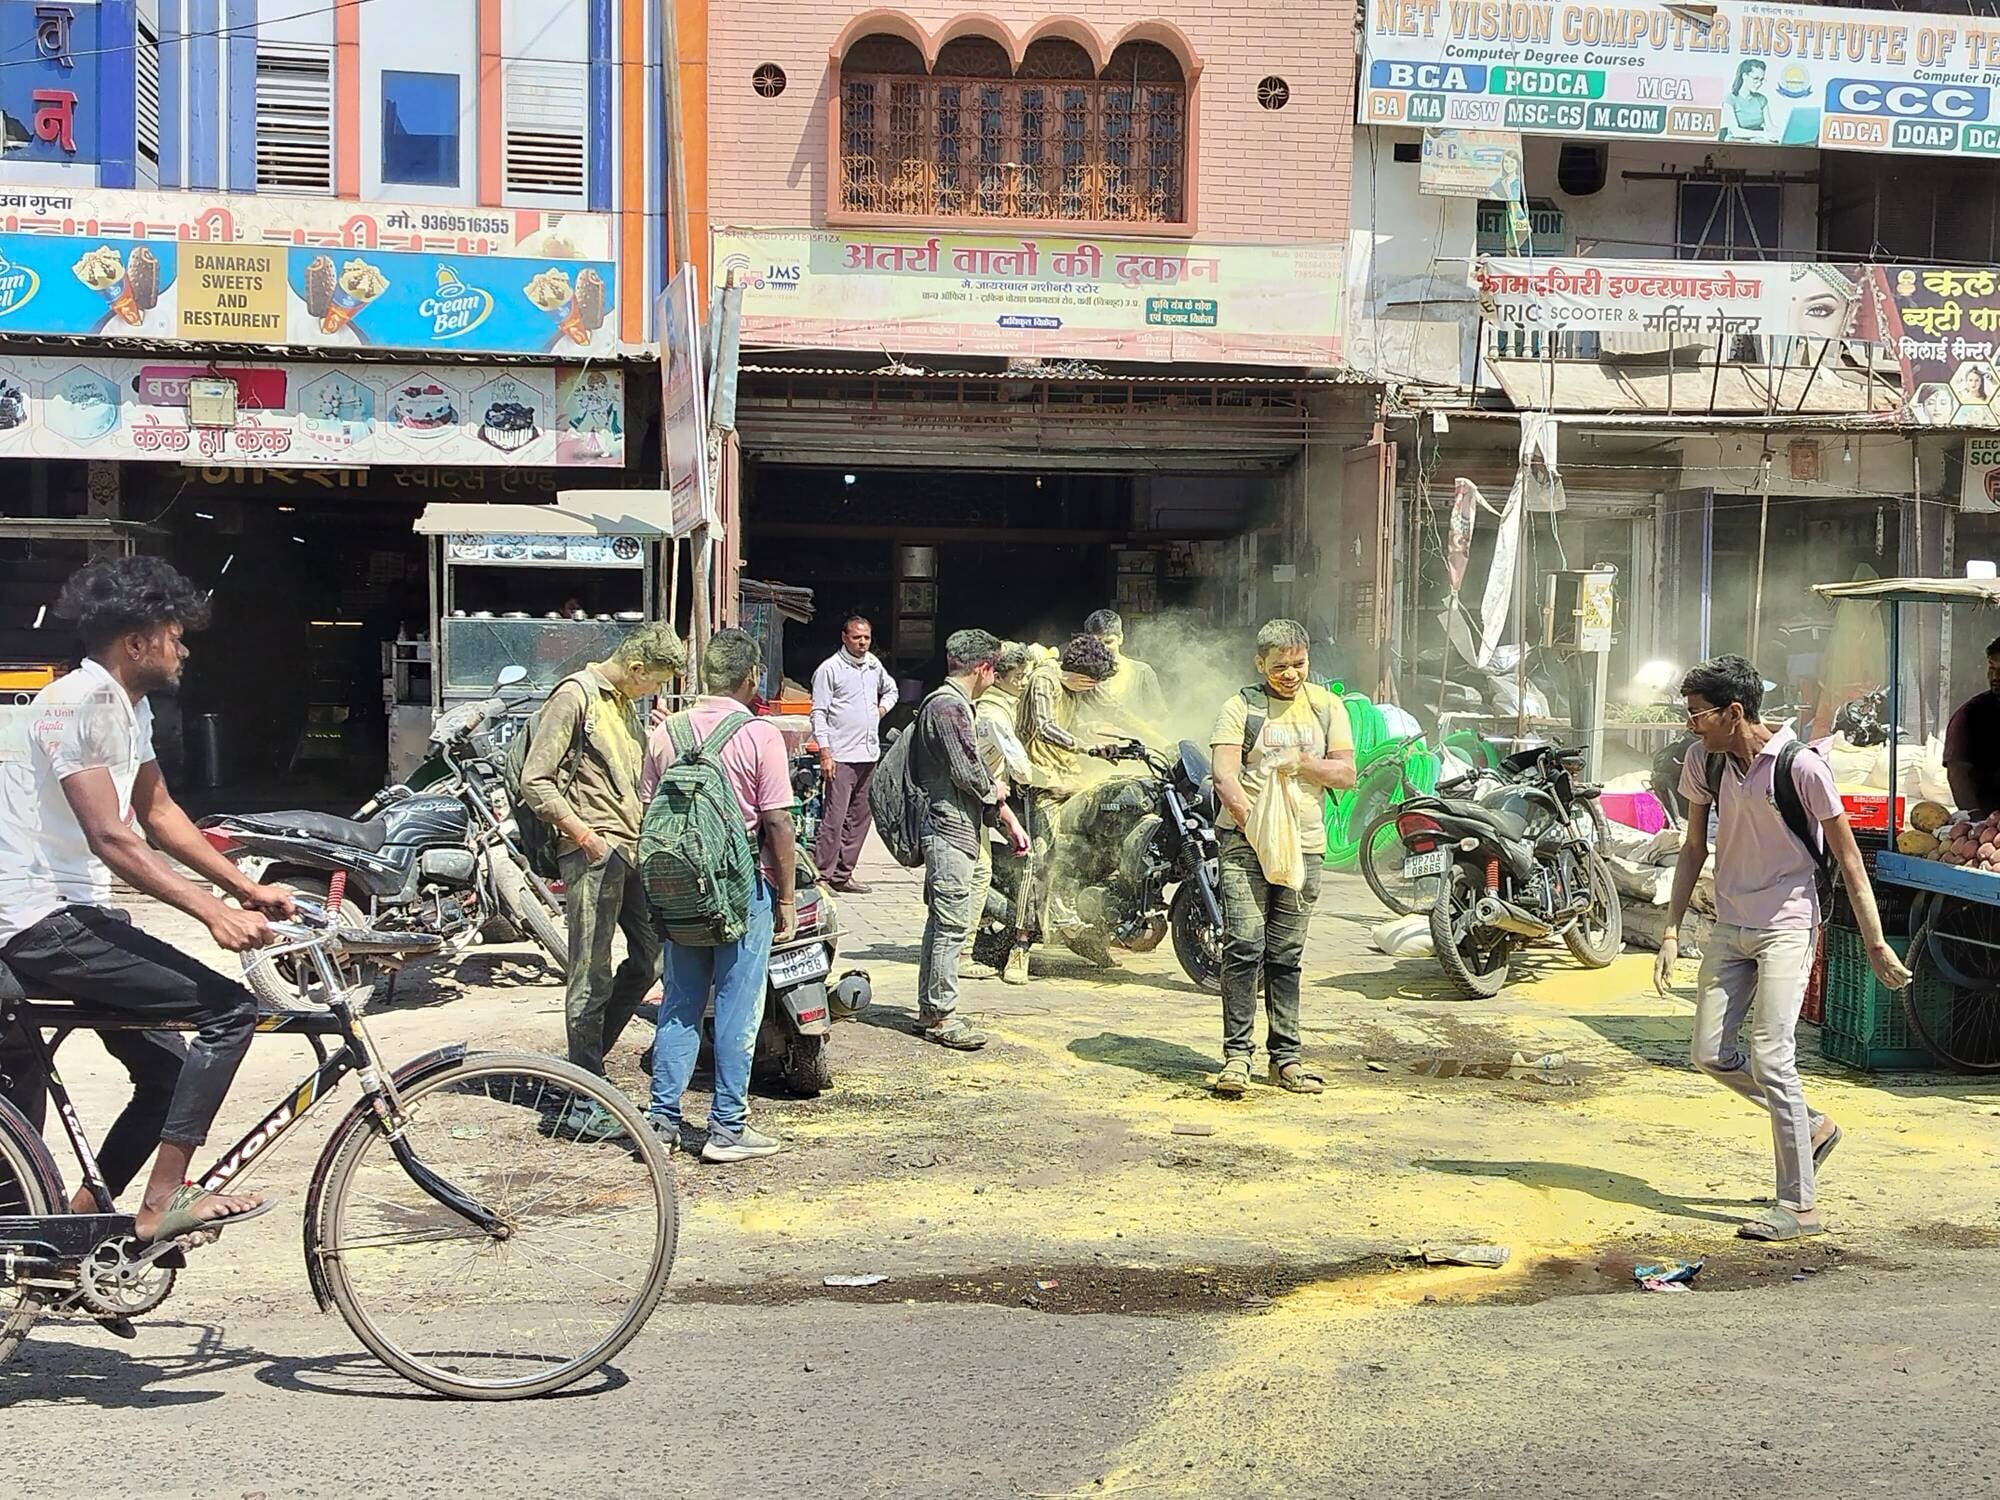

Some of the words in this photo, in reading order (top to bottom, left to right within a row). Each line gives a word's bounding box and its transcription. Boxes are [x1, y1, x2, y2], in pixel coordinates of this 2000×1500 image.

[1376, 0, 1440, 37] NET
[1449, 2, 1553, 44] VISION
[1562, 5, 1730, 54] COMPUTER
[1739, 15, 1908, 65] INSTITUTE
[1916, 27, 1956, 68] OF
[1445, 44, 1520, 62] Computer
[1524, 49, 1579, 65] Degree
[1584, 51, 1645, 67] Courses
[1388, 63, 1468, 90] BCA
[1504, 70, 1589, 95] PGDCA
[1913, 69, 1979, 84] Computer
[1638, 77, 1694, 100] MCA
[1374, 96, 1399, 116] BA
[1411, 97, 1442, 118] MA
[1451, 100, 1500, 122] MSW
[1839, 83, 1976, 117] CCC
[1507, 103, 1582, 125] MSC-CS
[1593, 107, 1659, 129] M.COM
[1673, 112, 1716, 132] MBA
[1828, 121, 1883, 142] ADCA
[1898, 124, 1954, 146] DOAP
[1969, 128, 2000, 149] DC
[30, 195, 72, 214] गुप्ता
[386, 210, 416, 231] मो.
[421, 213, 510, 234] 9369516355
[1477, 211, 1503, 233] NET
[194, 255, 271, 273] BANARASI
[766, 265, 801, 280] JMS
[843, 238, 940, 274] अतर्रा
[1051, 242, 1104, 279] की
[1115, 254, 1221, 289] दुकान
[201, 275, 263, 291] SWEETS
[976, 281, 1028, 293] जायसवाल
[1030, 280, 1071, 294] मशीनरी
[1075, 281, 1100, 295] स्टोर
[1607, 270, 1763, 300] इण्टरप्राइजेज
[216, 294, 247, 308] AND
[419, 294, 480, 317] Cream
[183, 310, 280, 329] RESTAURENT
[433, 311, 470, 333] Bell
[1550, 306, 1623, 321] SCOOTER
[1627, 311, 1639, 321] &
[1643, 304, 1702, 333] सर्विस
[1902, 300, 1963, 337] ब्यूटी
[1968, 307, 2000, 332] पा
[1899, 336, 1949, 363] सिलाई
[131, 414, 190, 451] केक
[234, 416, 291, 453] केक
[204, 1104, 294, 1192] AVON
